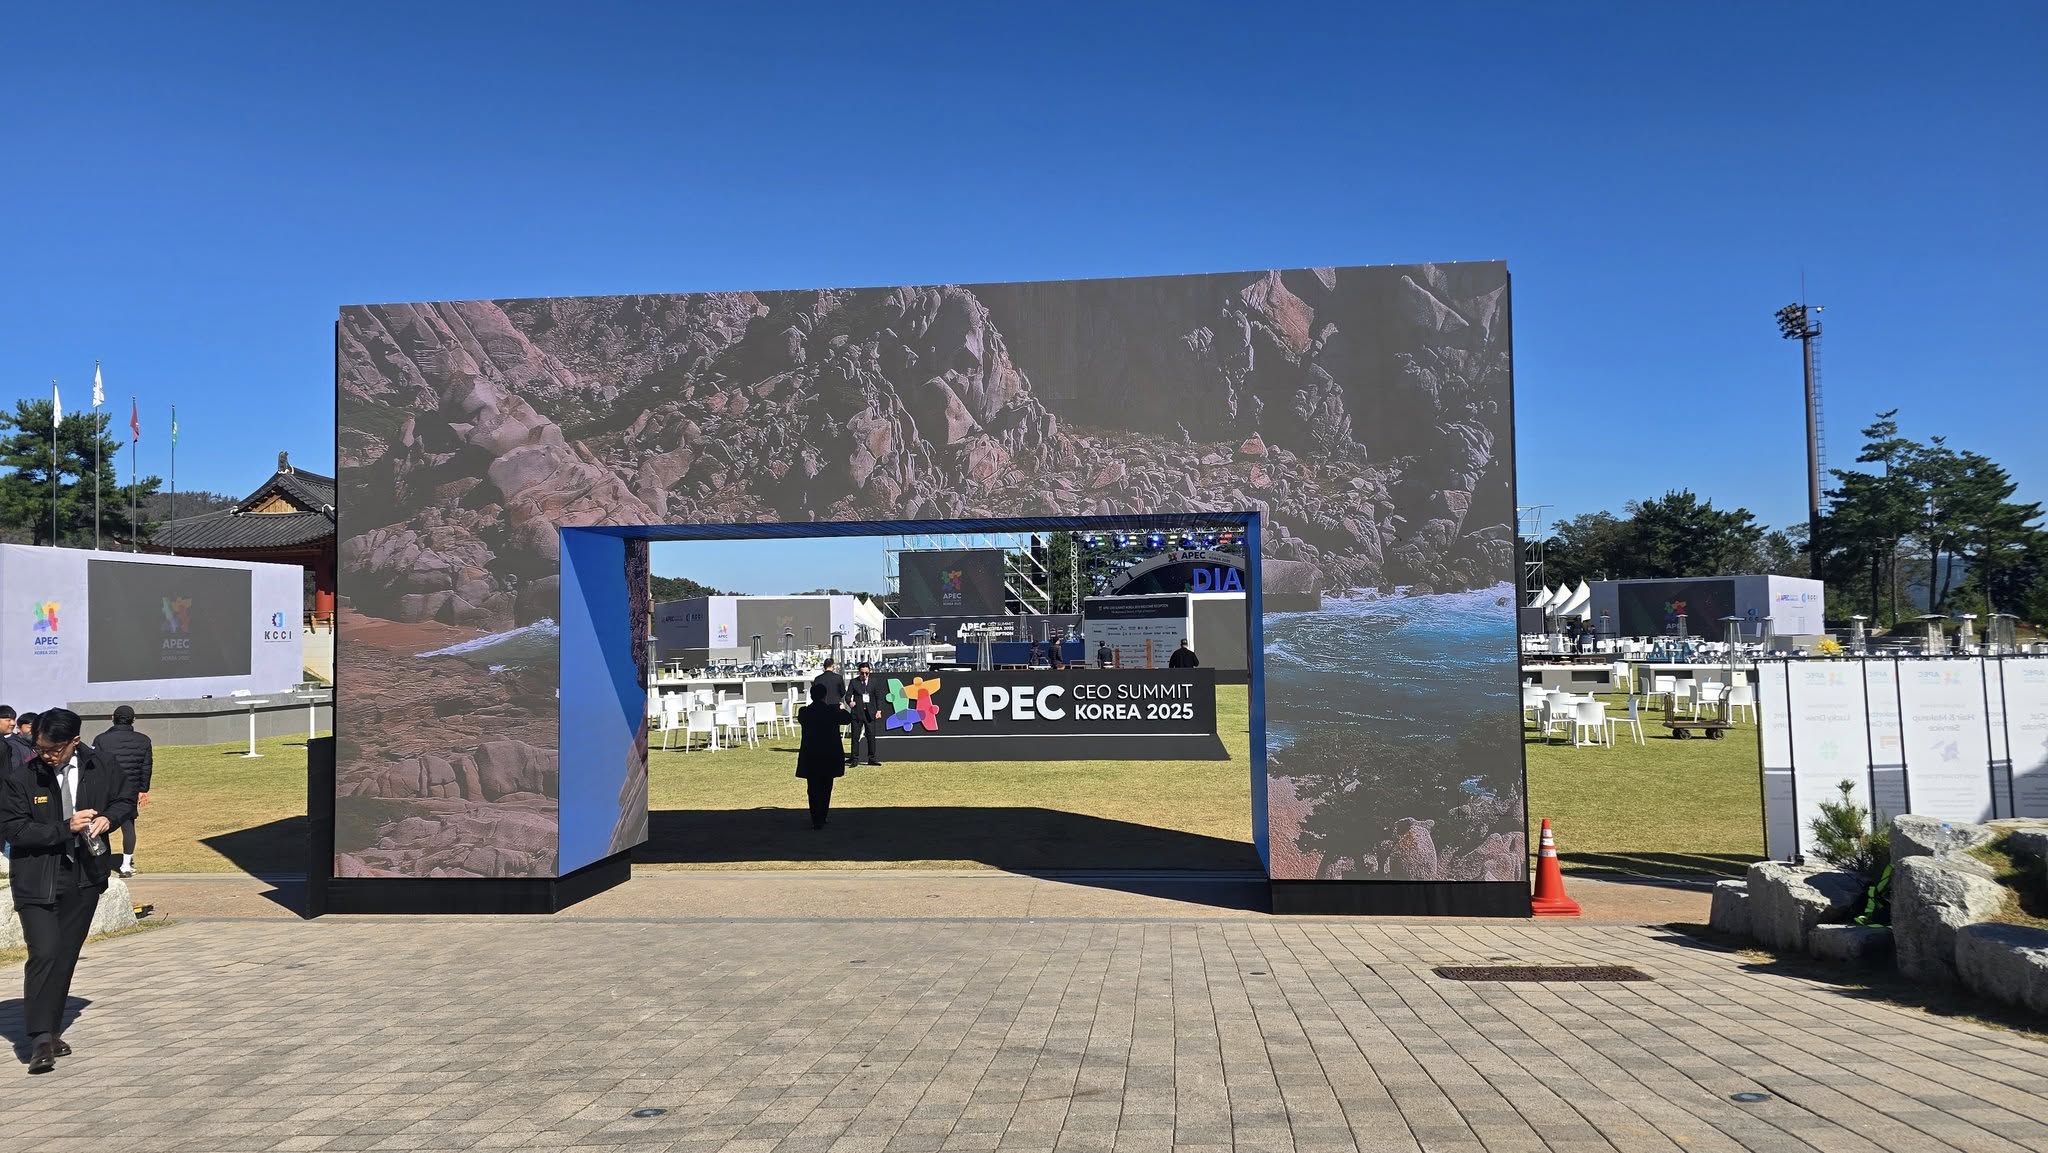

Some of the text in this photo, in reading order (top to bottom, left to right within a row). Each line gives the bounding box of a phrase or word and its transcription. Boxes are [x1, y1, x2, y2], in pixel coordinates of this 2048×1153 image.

[1181, 551, 1206, 560] APEC
[960, 623, 986, 631] APEC
[264, 631, 292, 640] KCCI
[34, 637, 59, 645] APEC
[162, 639, 191, 649] APEC
[949, 683, 1193, 720] APEC CEO SUMMIT
[1075, 703, 1194, 720] KOREA 2025
